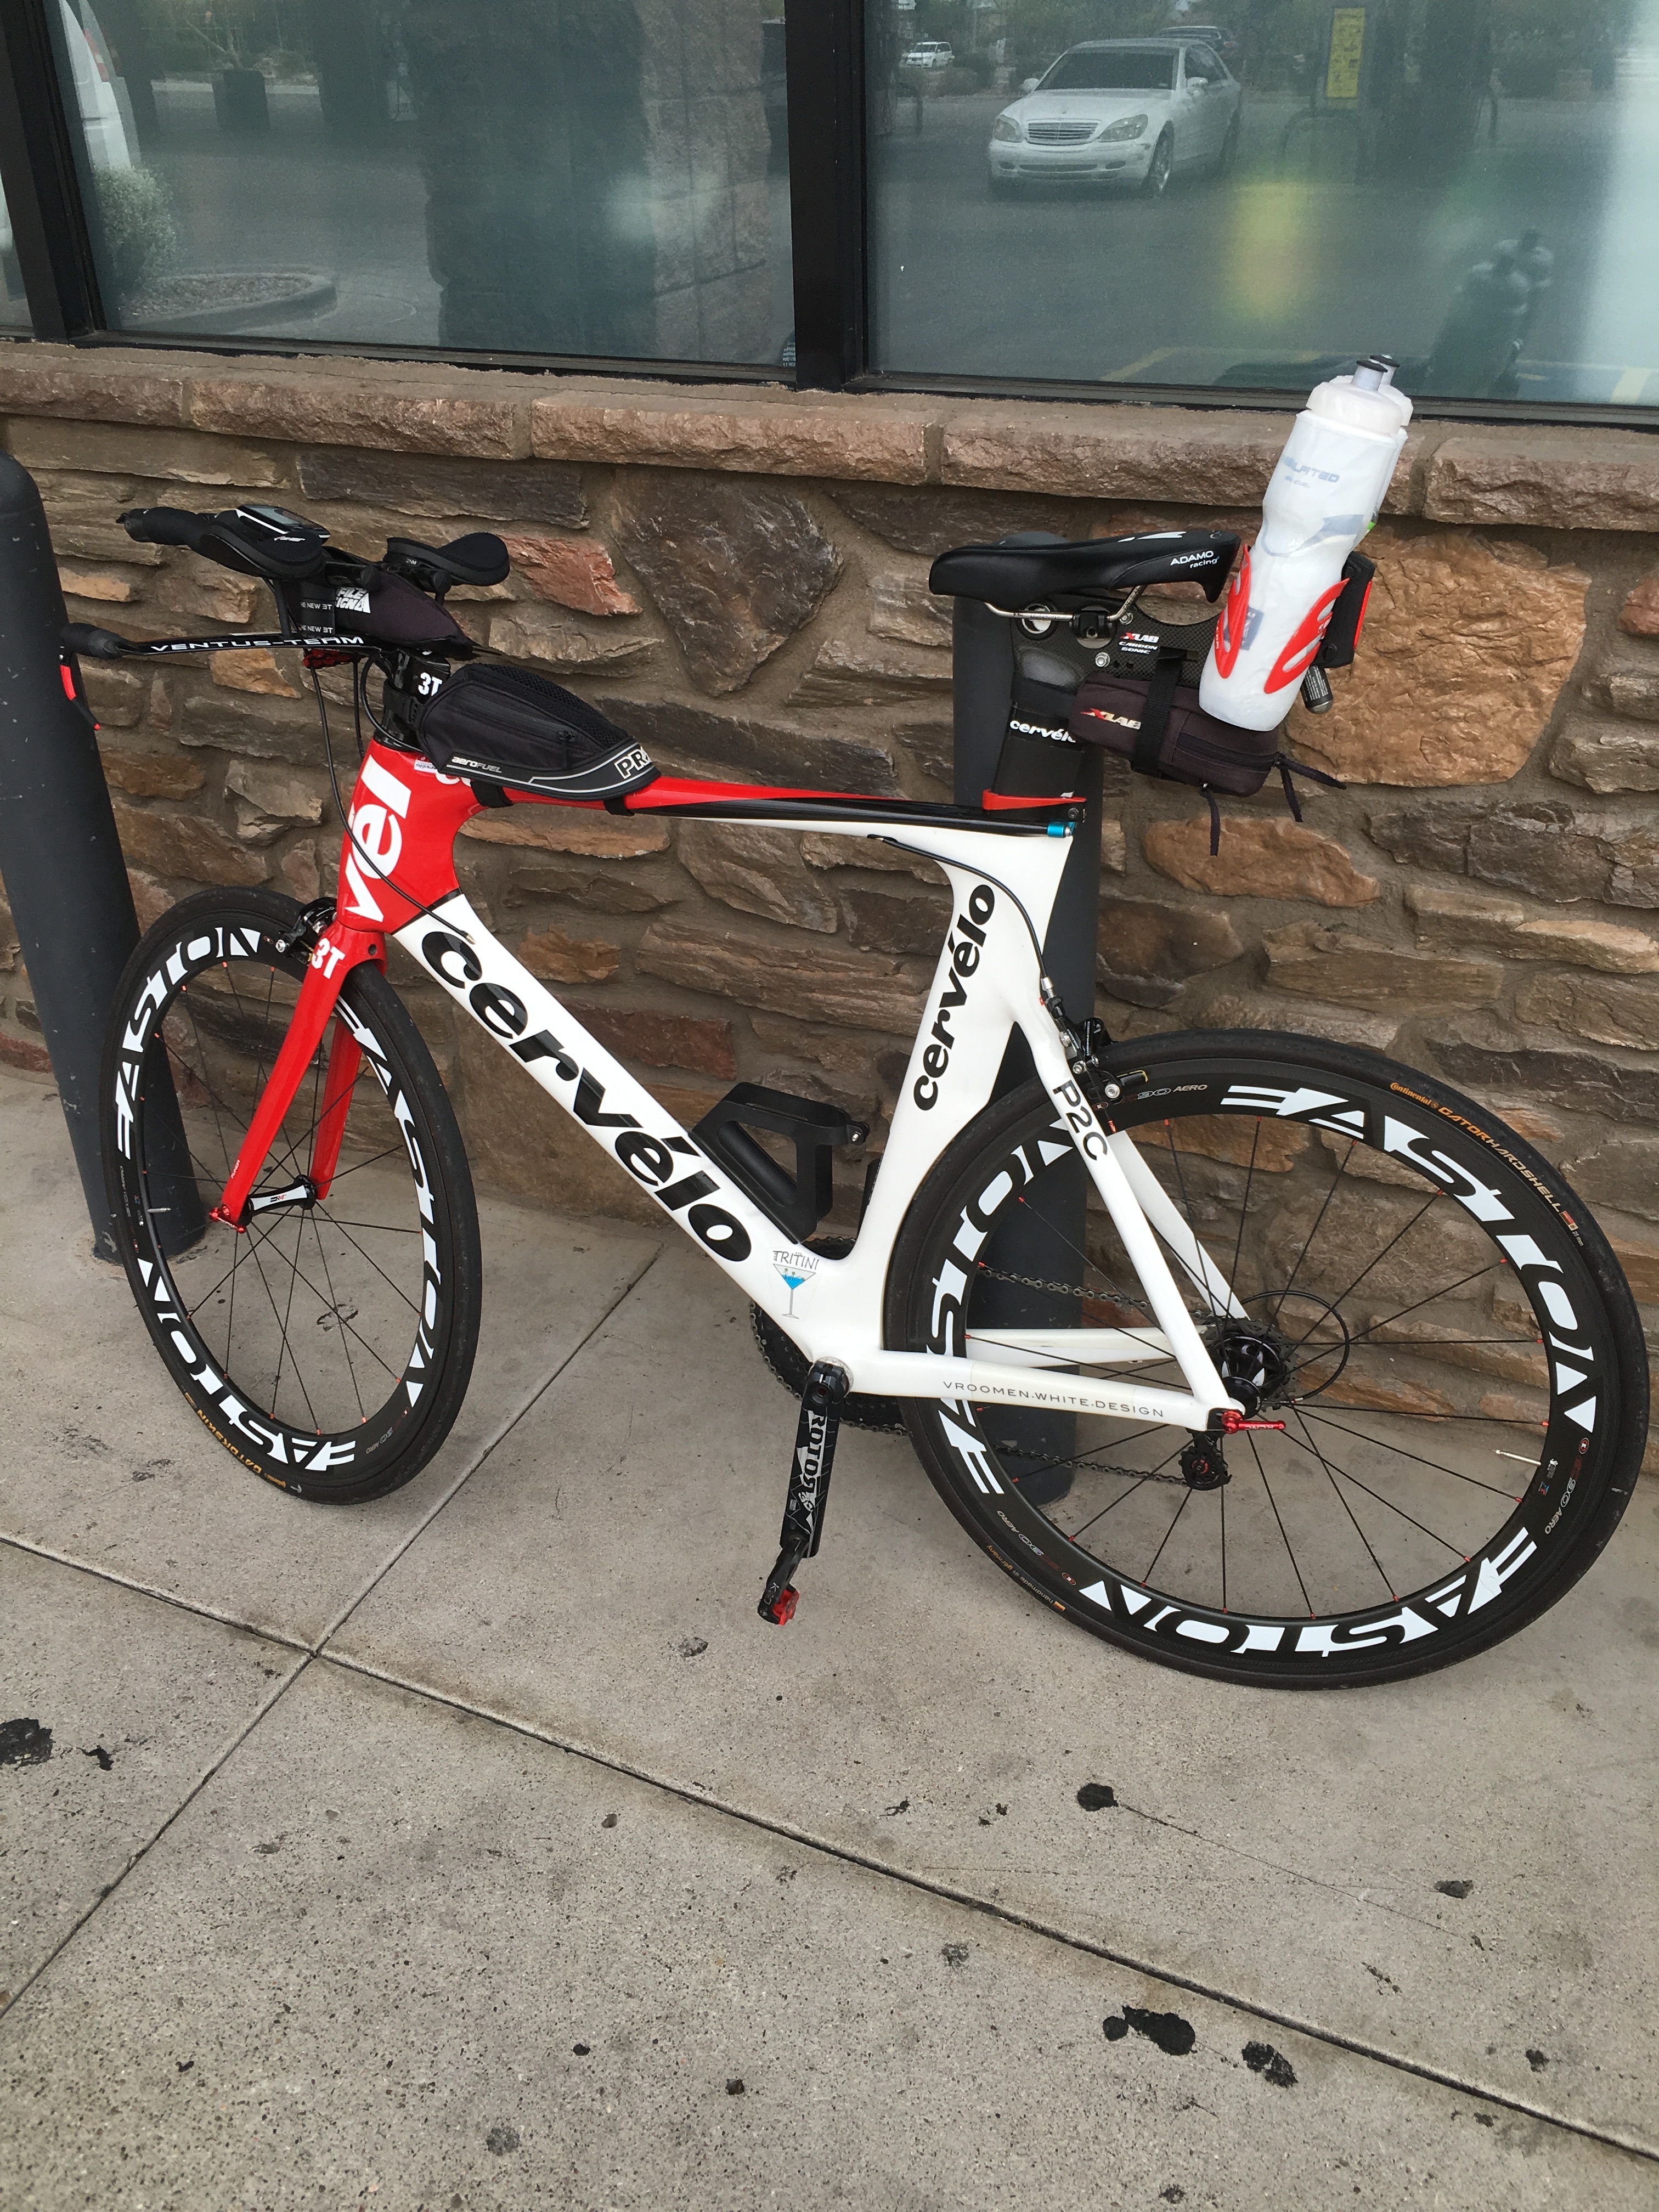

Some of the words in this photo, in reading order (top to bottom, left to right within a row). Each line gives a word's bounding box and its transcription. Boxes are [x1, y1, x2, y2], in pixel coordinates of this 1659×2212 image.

[1170, 551, 1214, 566] ADAMO
[1190, 557, 1217, 569] racing
[336, 587, 367, 600] FILE
[336, 597, 360, 611] IGN
[150, 636, 364, 652] VENTUS-TEAM
[1119, 641, 1158, 650] CARBON
[1120, 632, 1160, 644] XLAB
[418, 672, 443, 696] 3T
[1081, 708, 1141, 730] XLAB
[311, 937, 346, 979] 3T
[913, 884, 995, 1111] cervélo
[115, 927, 261, 1160] EASTON
[421, 931, 752, 1262] cervélo
[1173, 1084, 1208, 1092] AERO
[1390, 1082, 1432, 1106] Continental
[1052, 1079, 1108, 1161] P2C
[773, 1250, 820, 1270] TRITINI
[1221, 1085, 1597, 1432] EASTON
[137, 1258, 356, 1471] EASTON
[943, 1381, 1164, 1418] VROOMEN.WHITE.DESIGN
[801, 1415, 826, 1493] ROTOR
[997, 1510, 1019, 1533] AERO
[1544, 1507, 1562, 1534] AERO
[1079, 1527, 1538, 1657] EASTON
